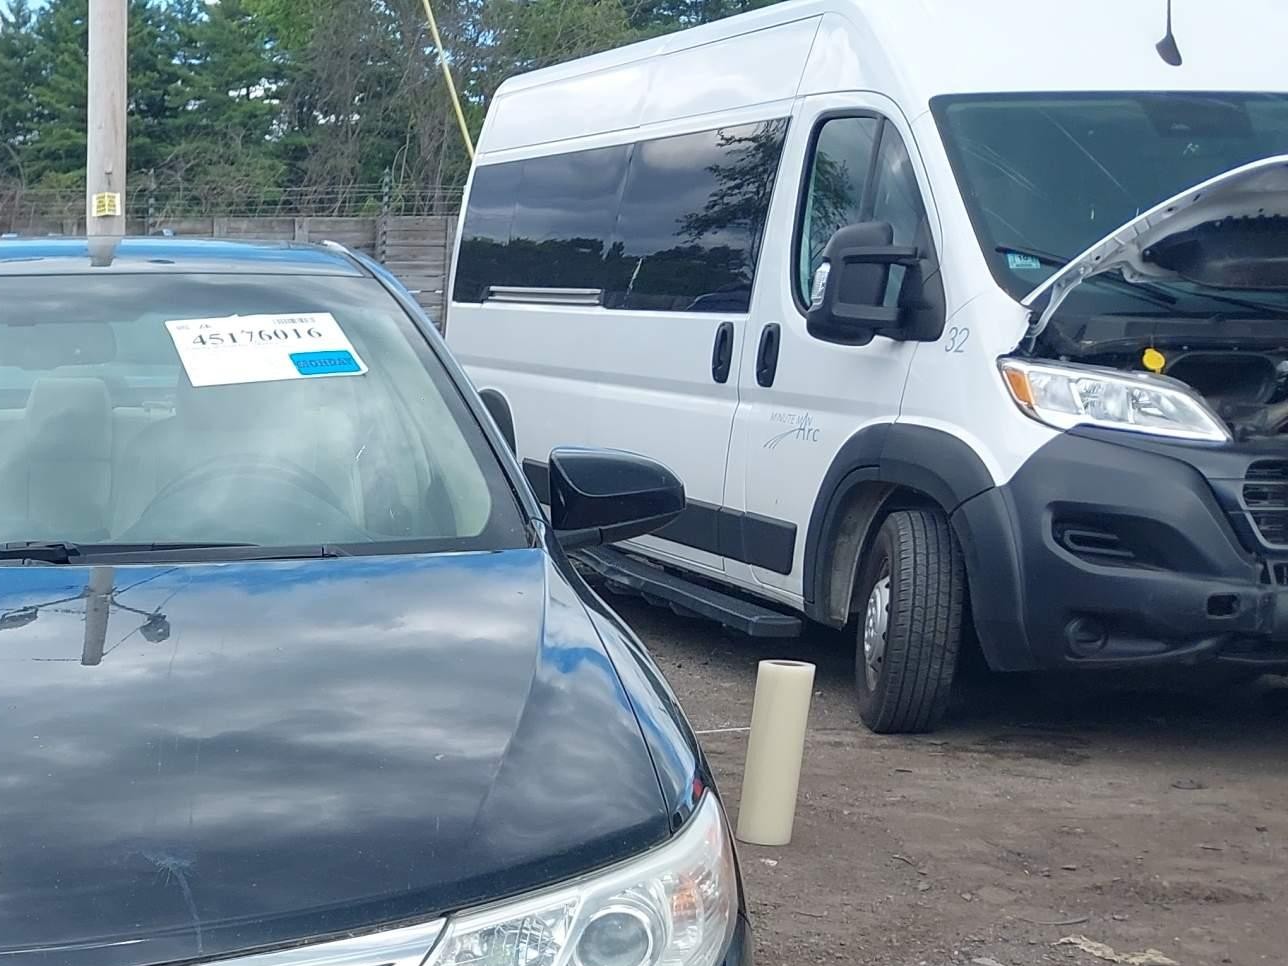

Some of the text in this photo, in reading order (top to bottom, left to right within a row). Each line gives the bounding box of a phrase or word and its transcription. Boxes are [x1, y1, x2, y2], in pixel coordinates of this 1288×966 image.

[192, 327, 323, 346] 45176016
[945, 326, 969, 352] 32
[795, 421, 820, 442] Arc
